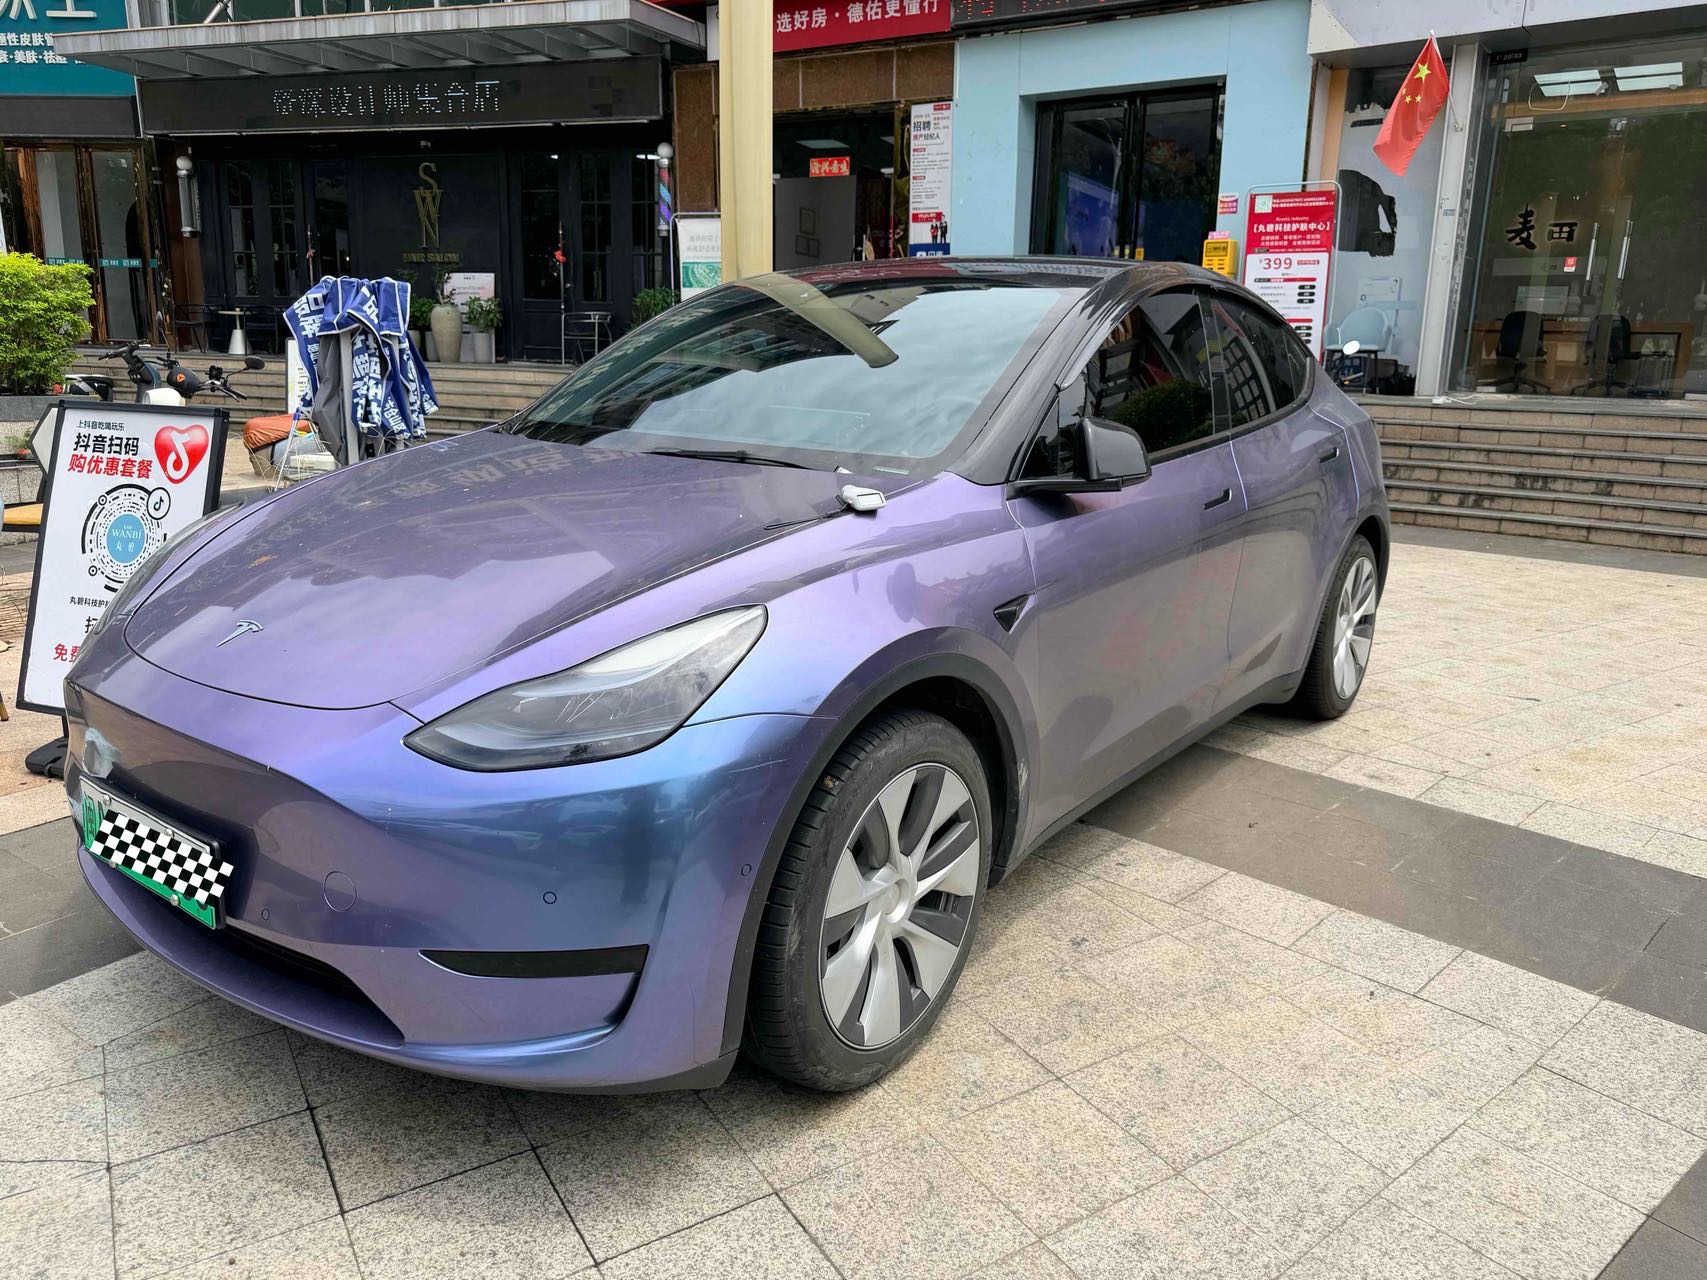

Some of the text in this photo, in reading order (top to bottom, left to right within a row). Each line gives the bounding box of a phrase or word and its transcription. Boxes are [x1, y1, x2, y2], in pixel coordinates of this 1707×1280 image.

[776, 0, 938, 33] 选好房·德佑更懂行
[913, 120, 931, 132] 招聘
[76, 420, 125, 431] 上抖音吃喝玩乐
[73, 433, 140, 456] 抖音扫码
[67, 454, 154, 480] 购优惠套餐
